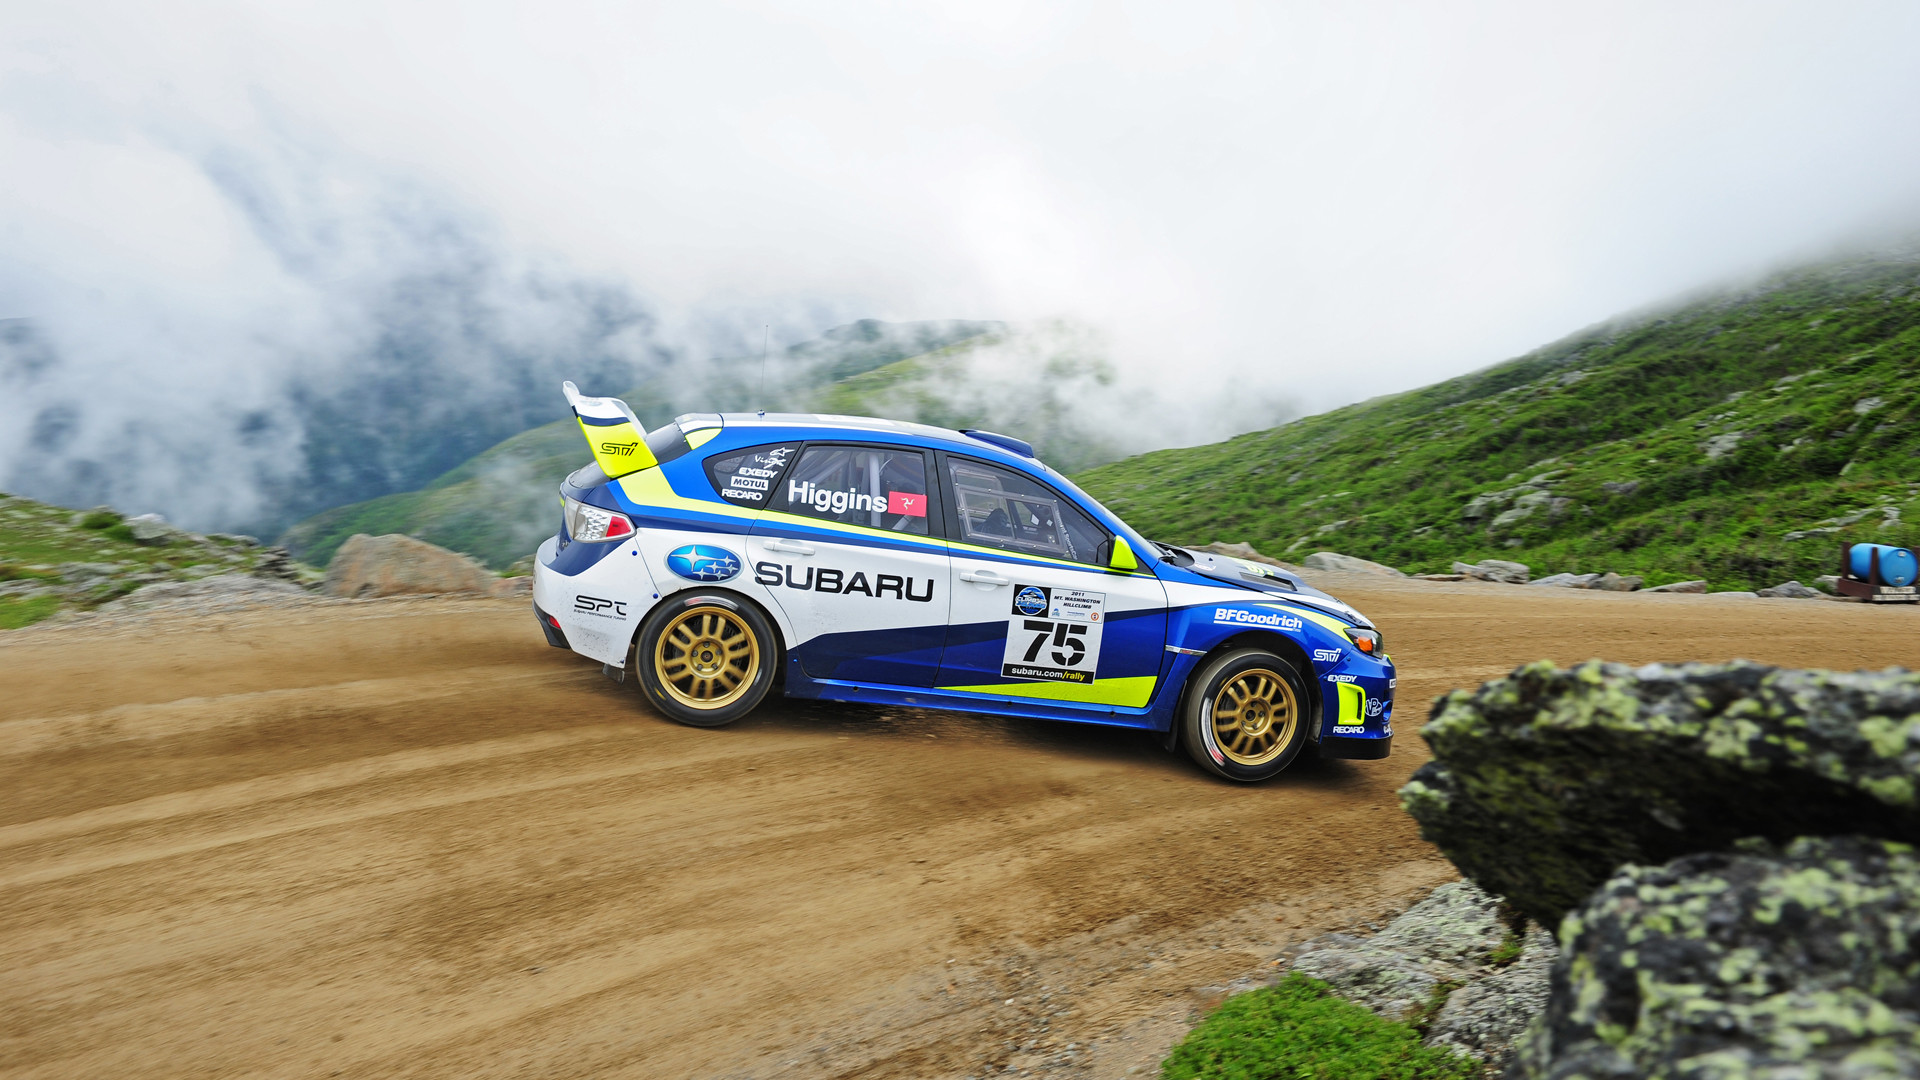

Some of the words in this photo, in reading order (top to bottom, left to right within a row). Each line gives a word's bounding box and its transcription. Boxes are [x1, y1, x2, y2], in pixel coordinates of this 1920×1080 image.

[739, 467, 778, 478] EXEDY
[733, 478, 766, 488] MOTUL
[721, 488, 763, 500] RECARO
[788, 479, 888, 514] Higgins
[754, 561, 934, 602] SUBARU
[1214, 608, 1303, 628] BFGoodrich
[1023, 620, 1087, 666] 75
[1012, 667, 1085, 681] subaru.com/rally
[1333, 726, 1365, 734] RECARO
